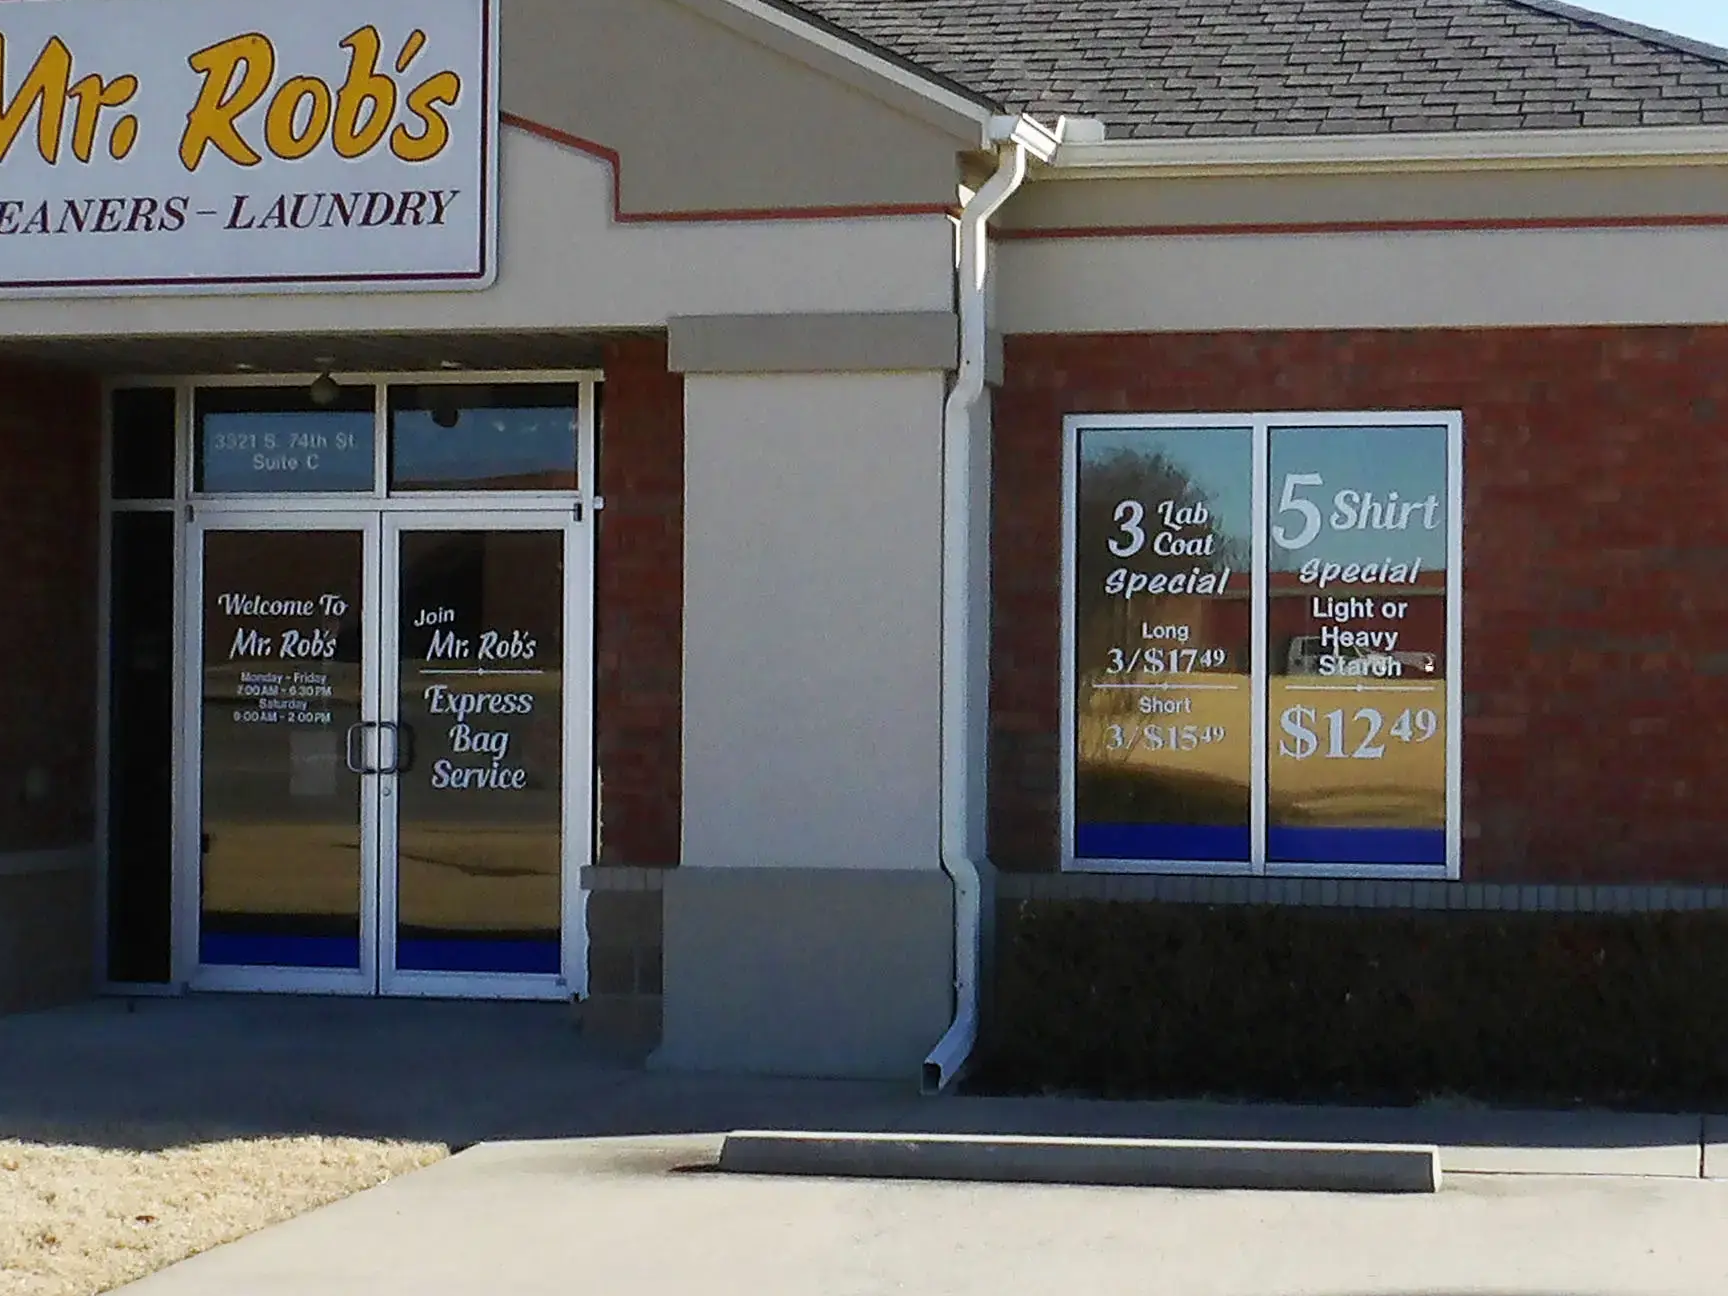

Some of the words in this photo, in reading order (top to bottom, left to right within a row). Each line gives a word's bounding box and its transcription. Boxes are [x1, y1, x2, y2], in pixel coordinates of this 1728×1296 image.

[179, 25, 461, 171] Rob's
[223, 189, 460, 231] LAUNDRY
[289, 432, 328, 449] 74th
[253, 454, 298, 470] Suite
[306, 454, 319, 470] C
[1158, 500, 1209, 530] Lab
[1272, 472, 1323, 550] 5
[1330, 489, 1441, 531] Shirt
[1108, 500, 1145, 557] 3
[1153, 532, 1214, 556] Coat
[1105, 566, 1230, 599] Special
[1299, 557, 1422, 588] Special
[218, 593, 314, 616] Welcome
[319, 593, 349, 616] To
[414, 607, 455, 627] Join
[1313, 597, 1374, 622] Light
[1381, 602, 1408, 619] or
[229, 627, 271, 659] Mr.
[280, 628, 336, 658] Rob's
[1142, 621, 1189, 642] Long
[1321, 626, 1399, 651] Heavy
[426, 629, 470, 662] Mr.
[478, 629, 537, 660] Rob's
[241, 671, 283, 684] Monday
[293, 671, 327, 684] Friday
[1318, 655, 1402, 677] Starch
[259, 698, 307, 710] Saturday
[424, 684, 534, 722] Express
[1139, 696, 1192, 713] Short
[449, 723, 509, 760] Bag
[431, 758, 526, 789] Service
